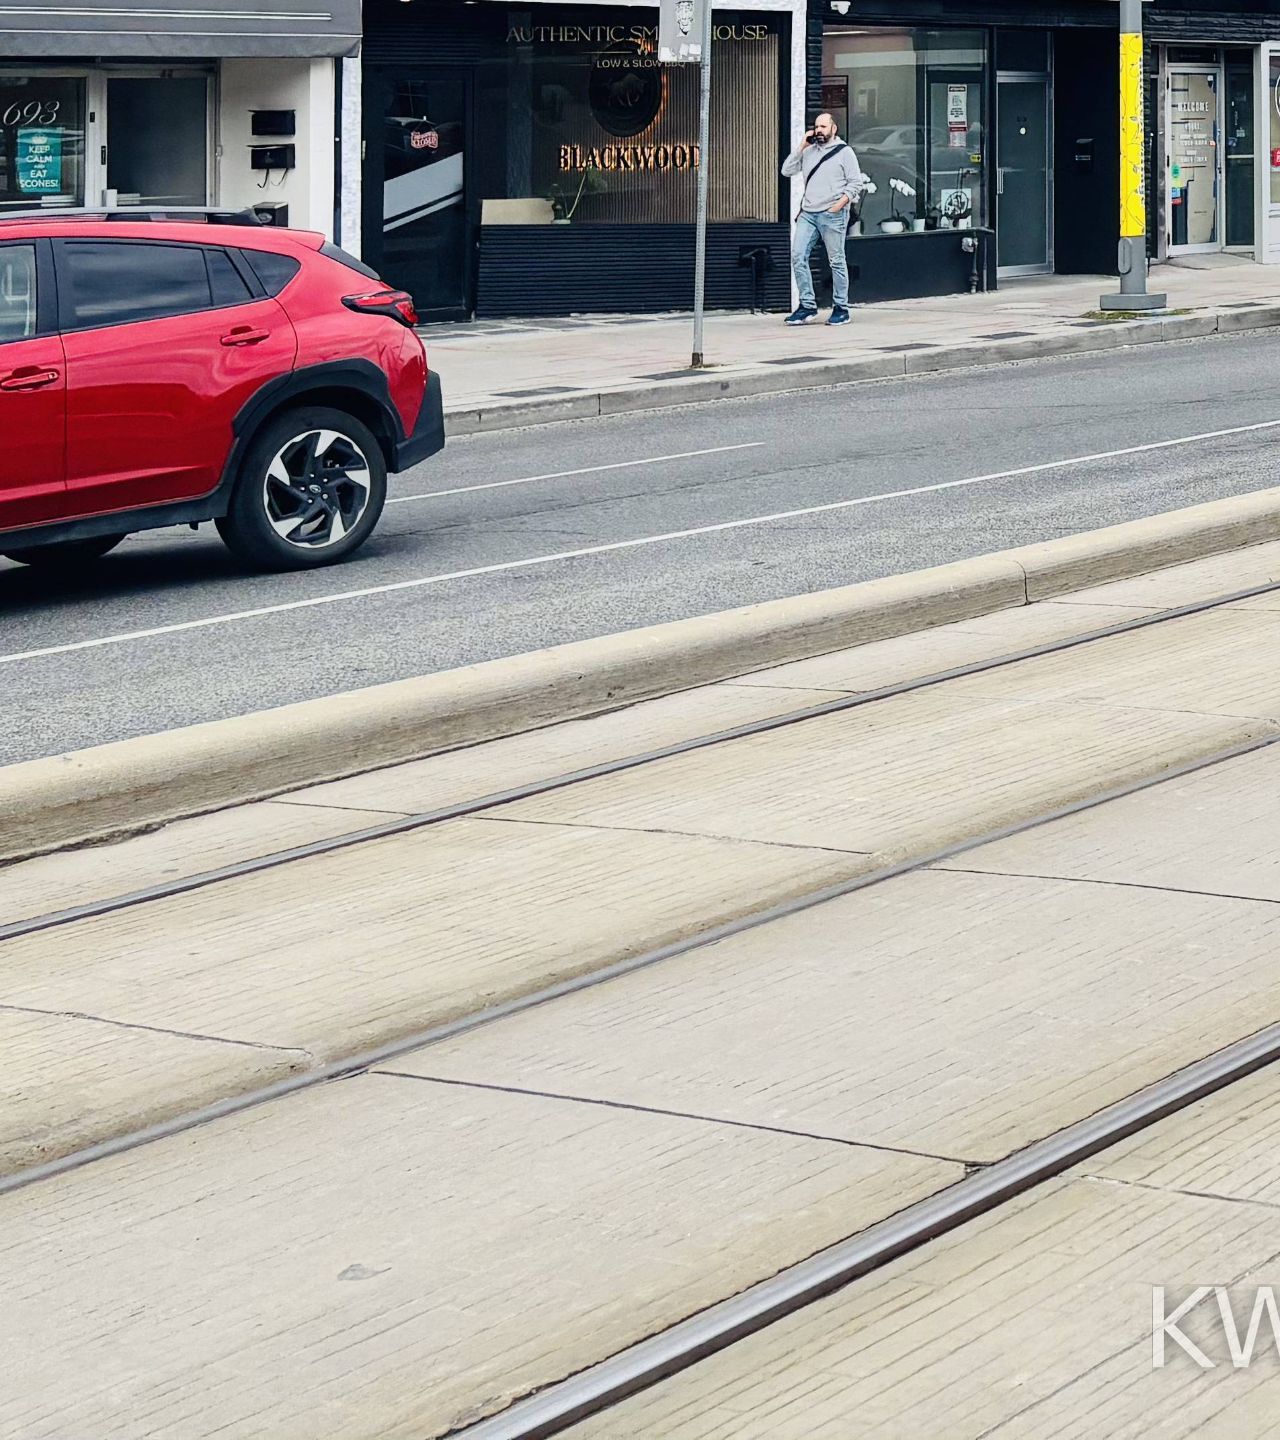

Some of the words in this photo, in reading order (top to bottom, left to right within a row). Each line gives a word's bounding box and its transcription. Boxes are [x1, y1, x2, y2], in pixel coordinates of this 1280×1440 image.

[505, 26, 625, 43] AUTHENTIC
[629, 25, 768, 42] SMOUSE
[597, 59, 620, 68] LOW
[623, 59, 630, 68] &
[632, 59, 663, 68] SLOW
[3, 101, 60, 127] 693
[29, 145, 51, 154] KEEP
[26, 155, 53, 163] CALM
[30, 170, 48, 178] EAT
[20, 179, 59, 189] SCONES!
